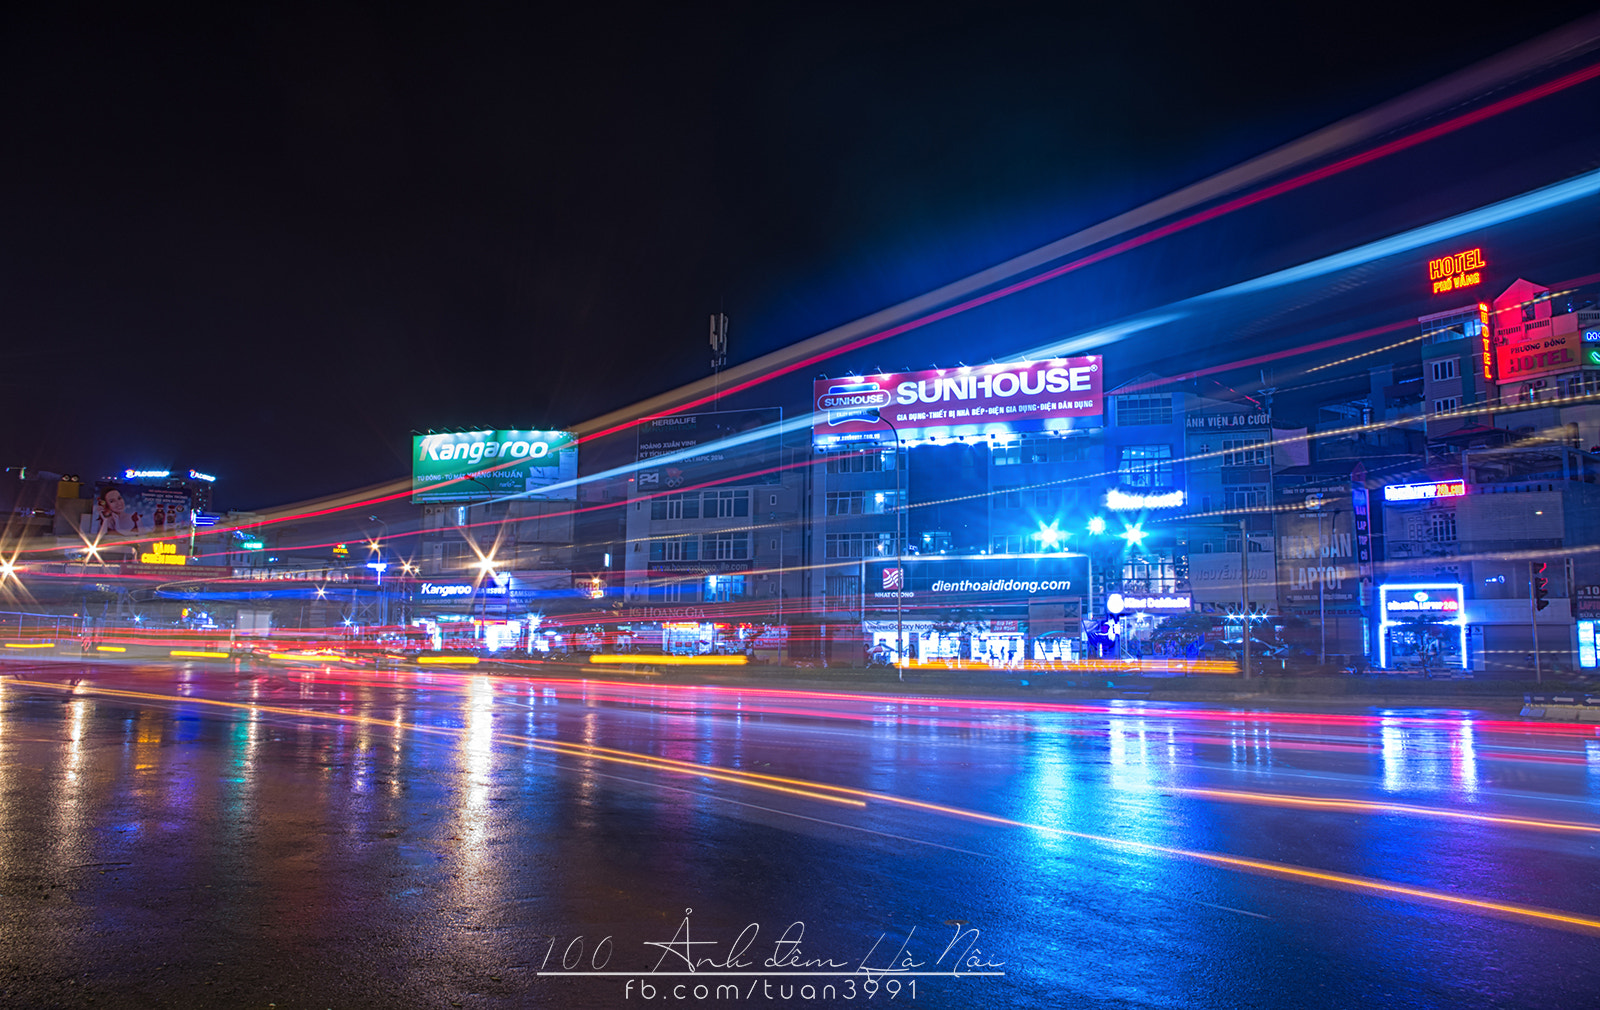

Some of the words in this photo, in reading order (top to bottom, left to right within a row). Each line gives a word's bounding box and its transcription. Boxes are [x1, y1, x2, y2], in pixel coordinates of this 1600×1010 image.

[1429, 248, 1486, 280] HOTEL
[1480, 313, 1492, 380] HOTEL
[1508, 348, 1574, 374] HOTEL
[896, 366, 1092, 406] SUNHOUSE
[824, 394, 884, 407] SUNHOUSE
[896, 414, 910, 422] GIA
[957, 407, 970, 417] NHÀ
[971, 405, 985, 415] BẾP
[1005, 405, 1017, 414] GIA
[1018, 404, 1037, 414] DỤNG
[1040, 402, 1057, 413] ĐIỆN
[1058, 400, 1073, 411] DÂN
[1074, 400, 1094, 411] DỤNG
[652, 417, 697, 427] HERBALIFE
[1186, 414, 1205, 428] ẢNH
[1208, 414, 1228, 428] VIỆN
[419, 435, 549, 465] Kangaroo
[492, 468, 523, 479] KHUẨN
[1195, 564, 1238, 581] NGUYỄN
[1290, 566, 1346, 590] LAPTOP
[421, 583, 472, 597] Kangaroo
[931, 579, 1072, 594] dienthoaididong.com
[888, 622, 914, 631] Gaaxy
